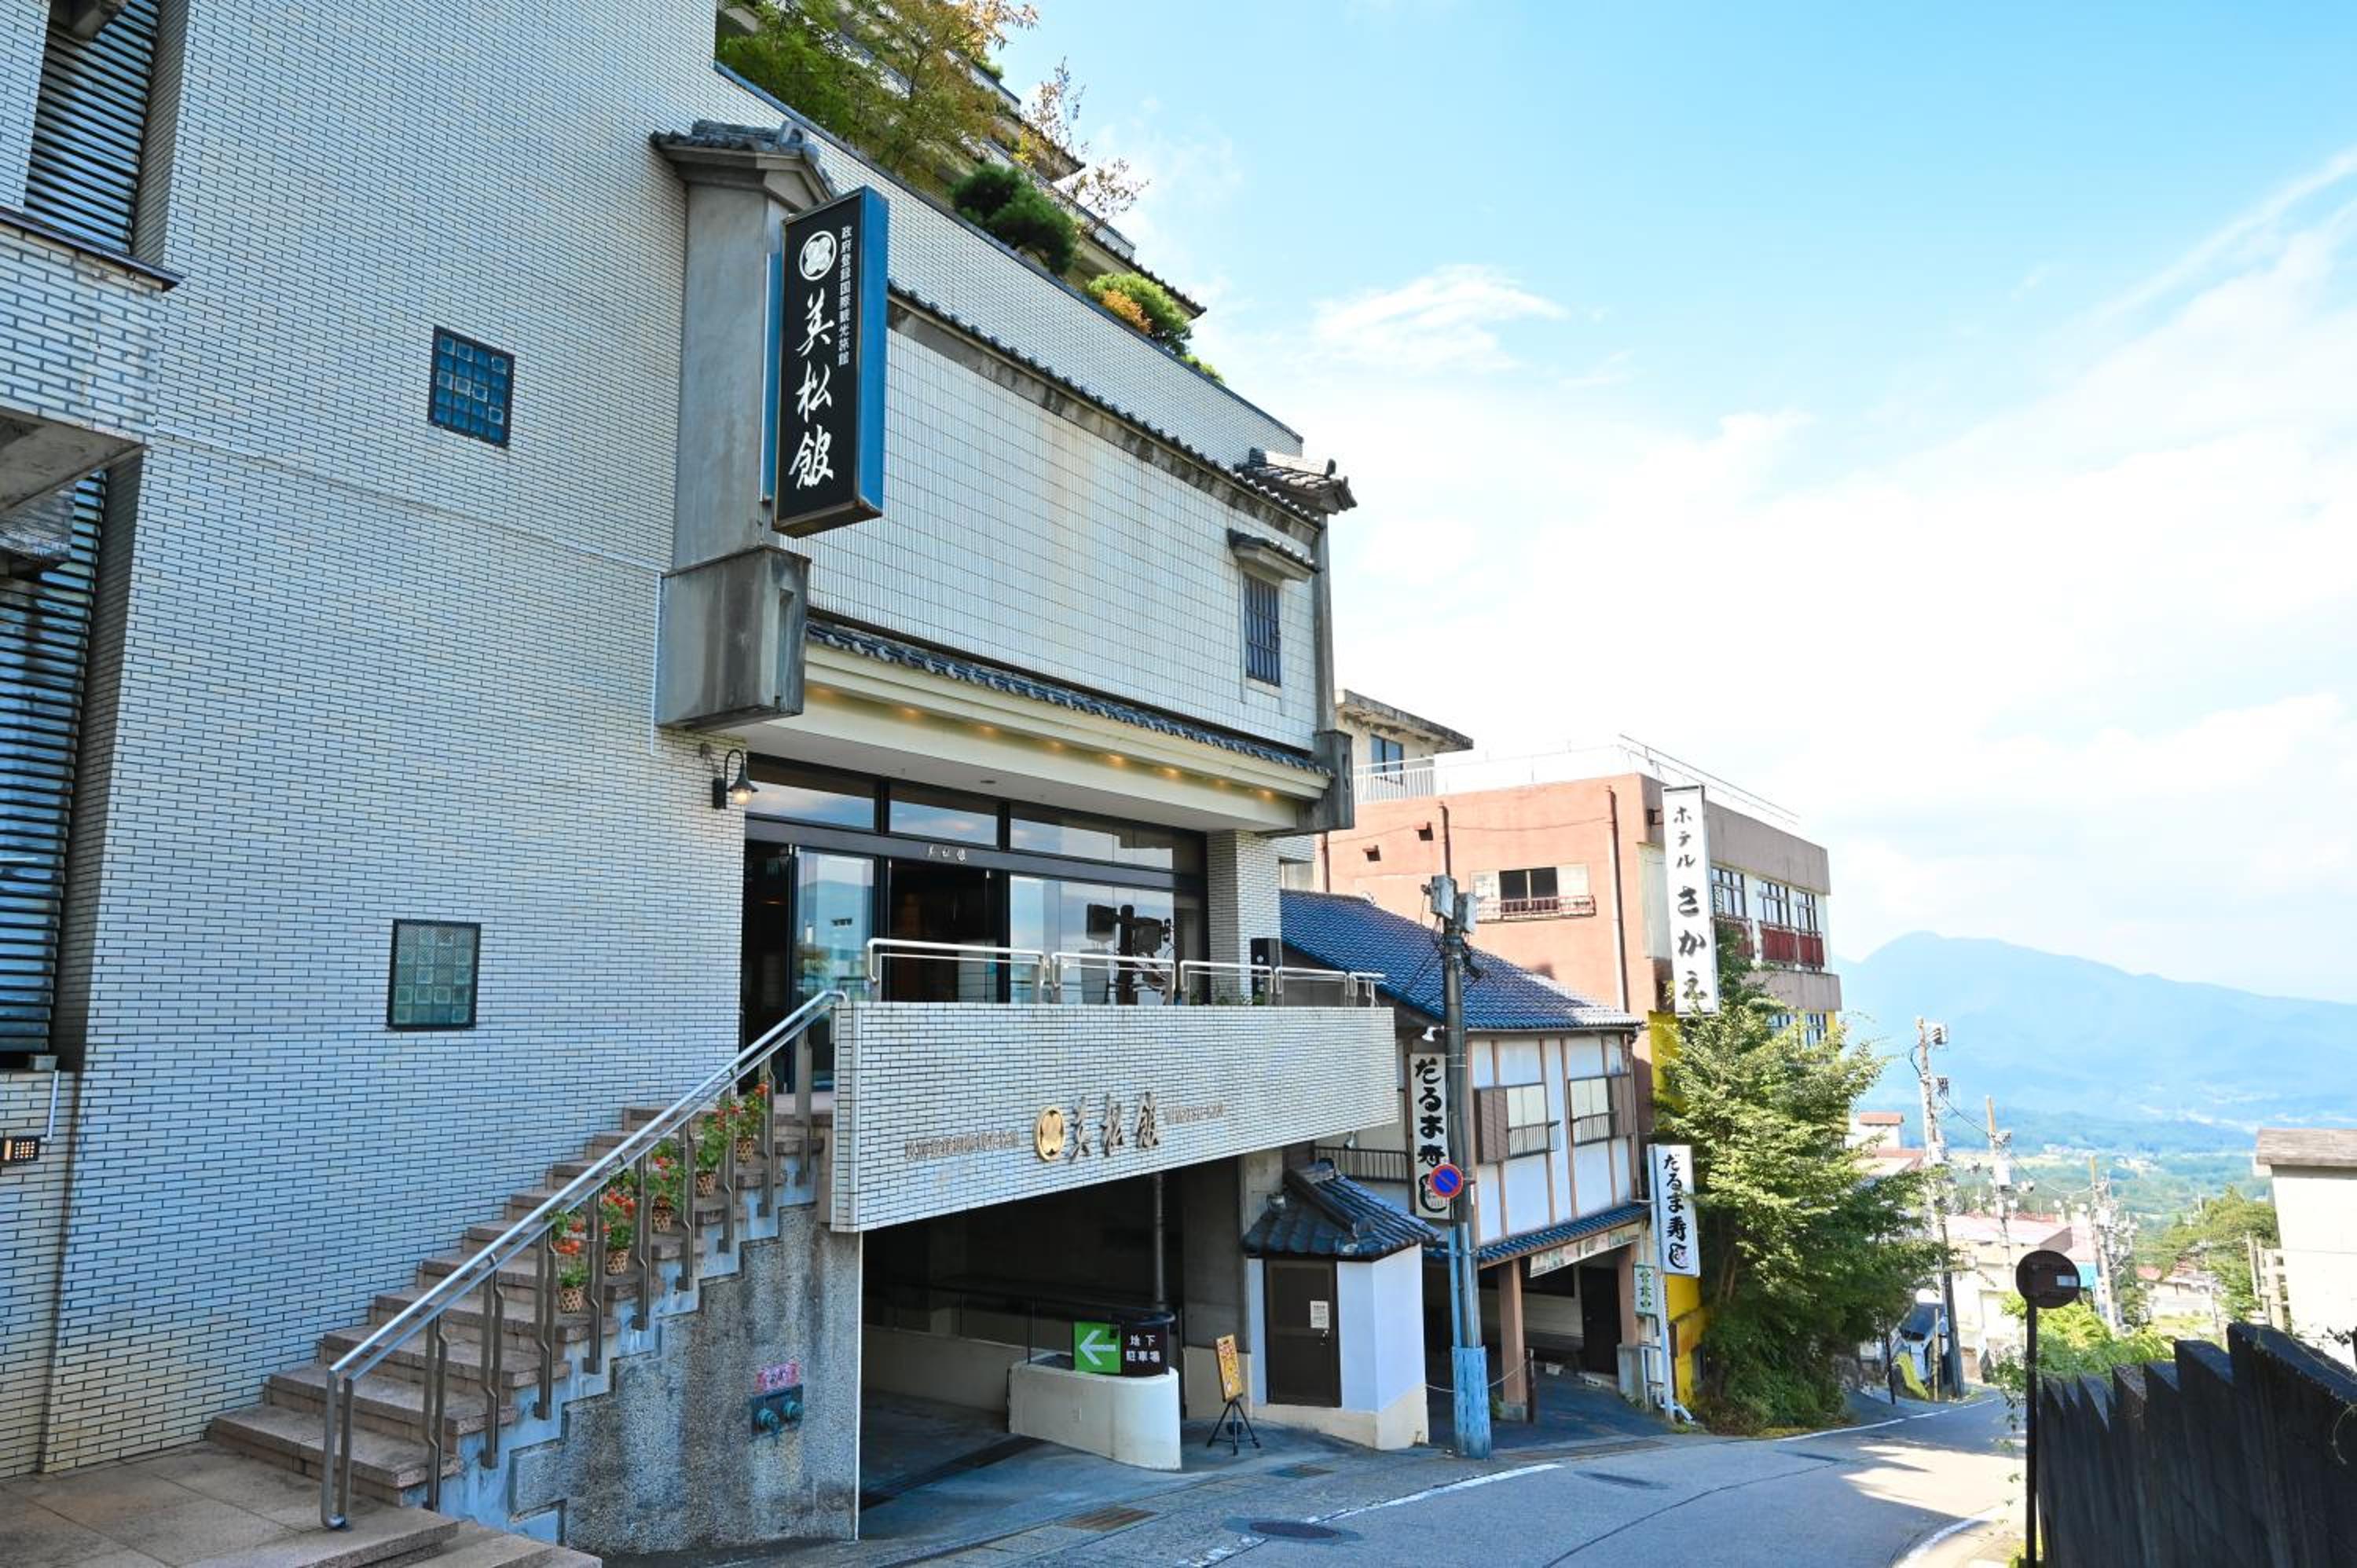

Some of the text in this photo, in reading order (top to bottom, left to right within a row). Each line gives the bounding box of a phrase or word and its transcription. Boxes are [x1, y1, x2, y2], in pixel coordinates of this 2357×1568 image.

[789, 288, 834, 489] 美松館
[1130, 1334, 1156, 1346] 地下
